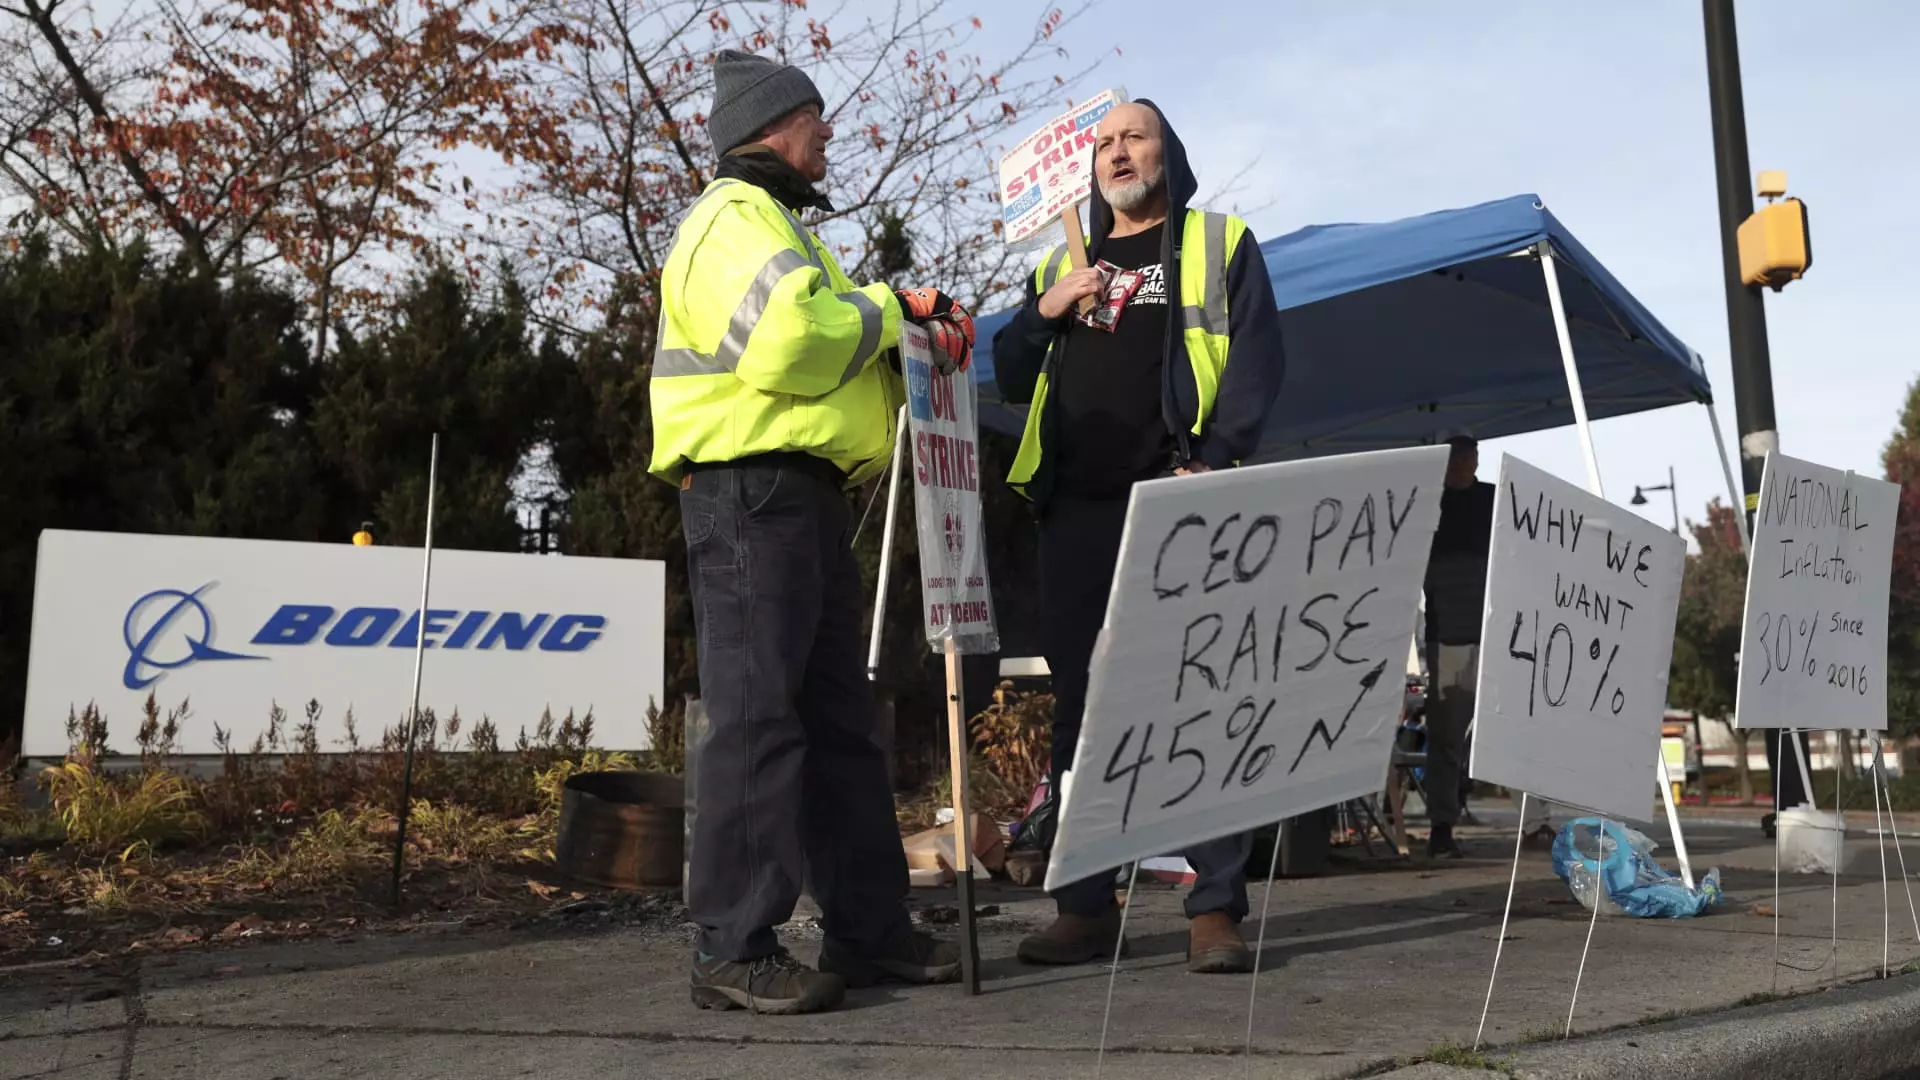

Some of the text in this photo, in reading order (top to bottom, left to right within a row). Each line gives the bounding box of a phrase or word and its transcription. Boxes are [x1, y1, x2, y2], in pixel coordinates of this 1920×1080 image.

[1006, 123, 1096, 200] STRIK
[1033, 119, 1077, 156] ON
[1137, 280, 1167, 296] BAC
[930, 366, 957, 423] ON
[916, 431, 977, 492] STRIKE
[1764, 468, 1869, 531] NATIONAL
[1153, 485, 1418, 600] CEO PAY
[1510, 481, 1653, 588] WHY WE
[250, 603, 607, 652] BOEING
[930, 603, 945, 626] AT
[1554, 572, 1634, 631] WANT
[1175, 587, 1379, 702] RAISE
[1509, 609, 1625, 717] 40%
[1756, 610, 1864, 687] 30% Since
[1827, 663, 1869, 696] 2016
[1103, 695, 1276, 833] 45%
